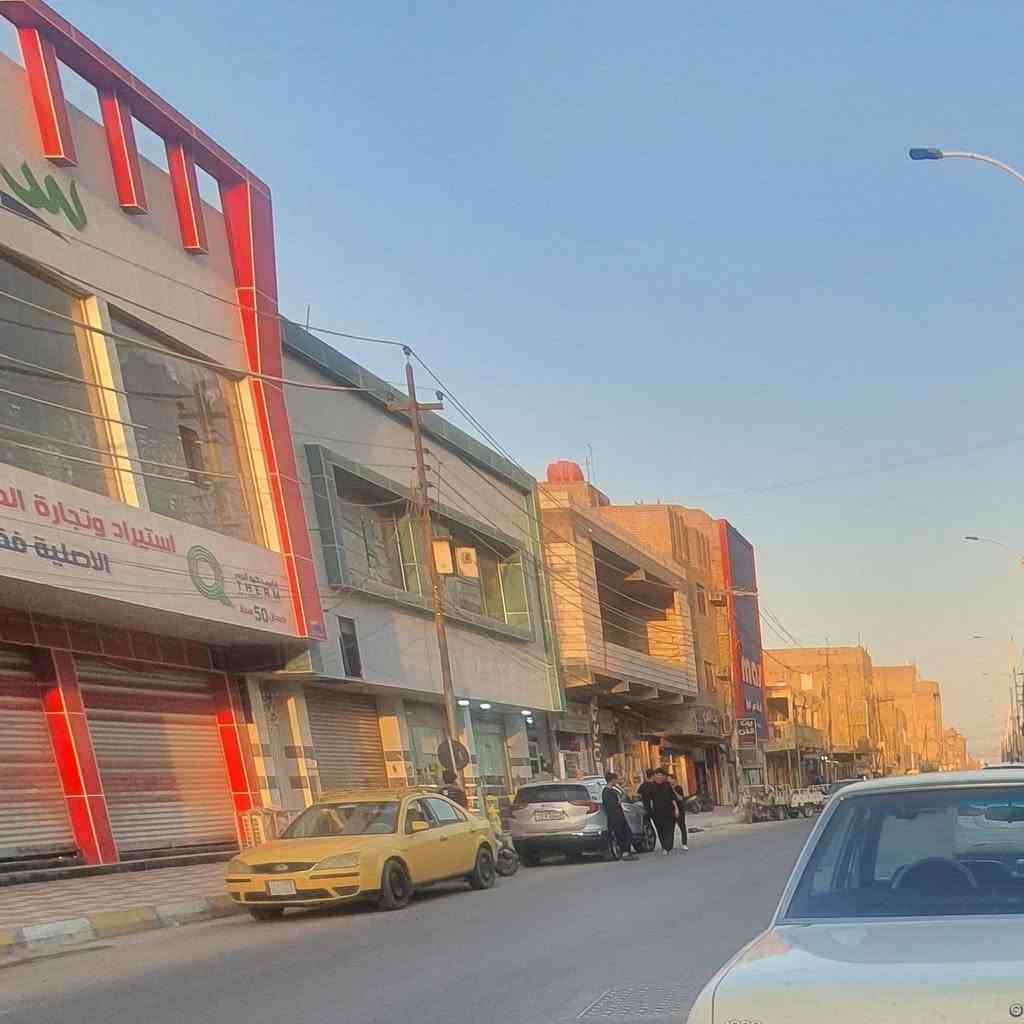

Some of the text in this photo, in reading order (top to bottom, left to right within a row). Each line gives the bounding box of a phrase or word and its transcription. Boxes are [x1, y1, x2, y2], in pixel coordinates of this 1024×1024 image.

[34, 493, 105, 538] وتجارة
[112, 519, 176, 553] استيراد
[33, 535, 112, 574] الاصلية
[254, 605, 269, 623] 50
